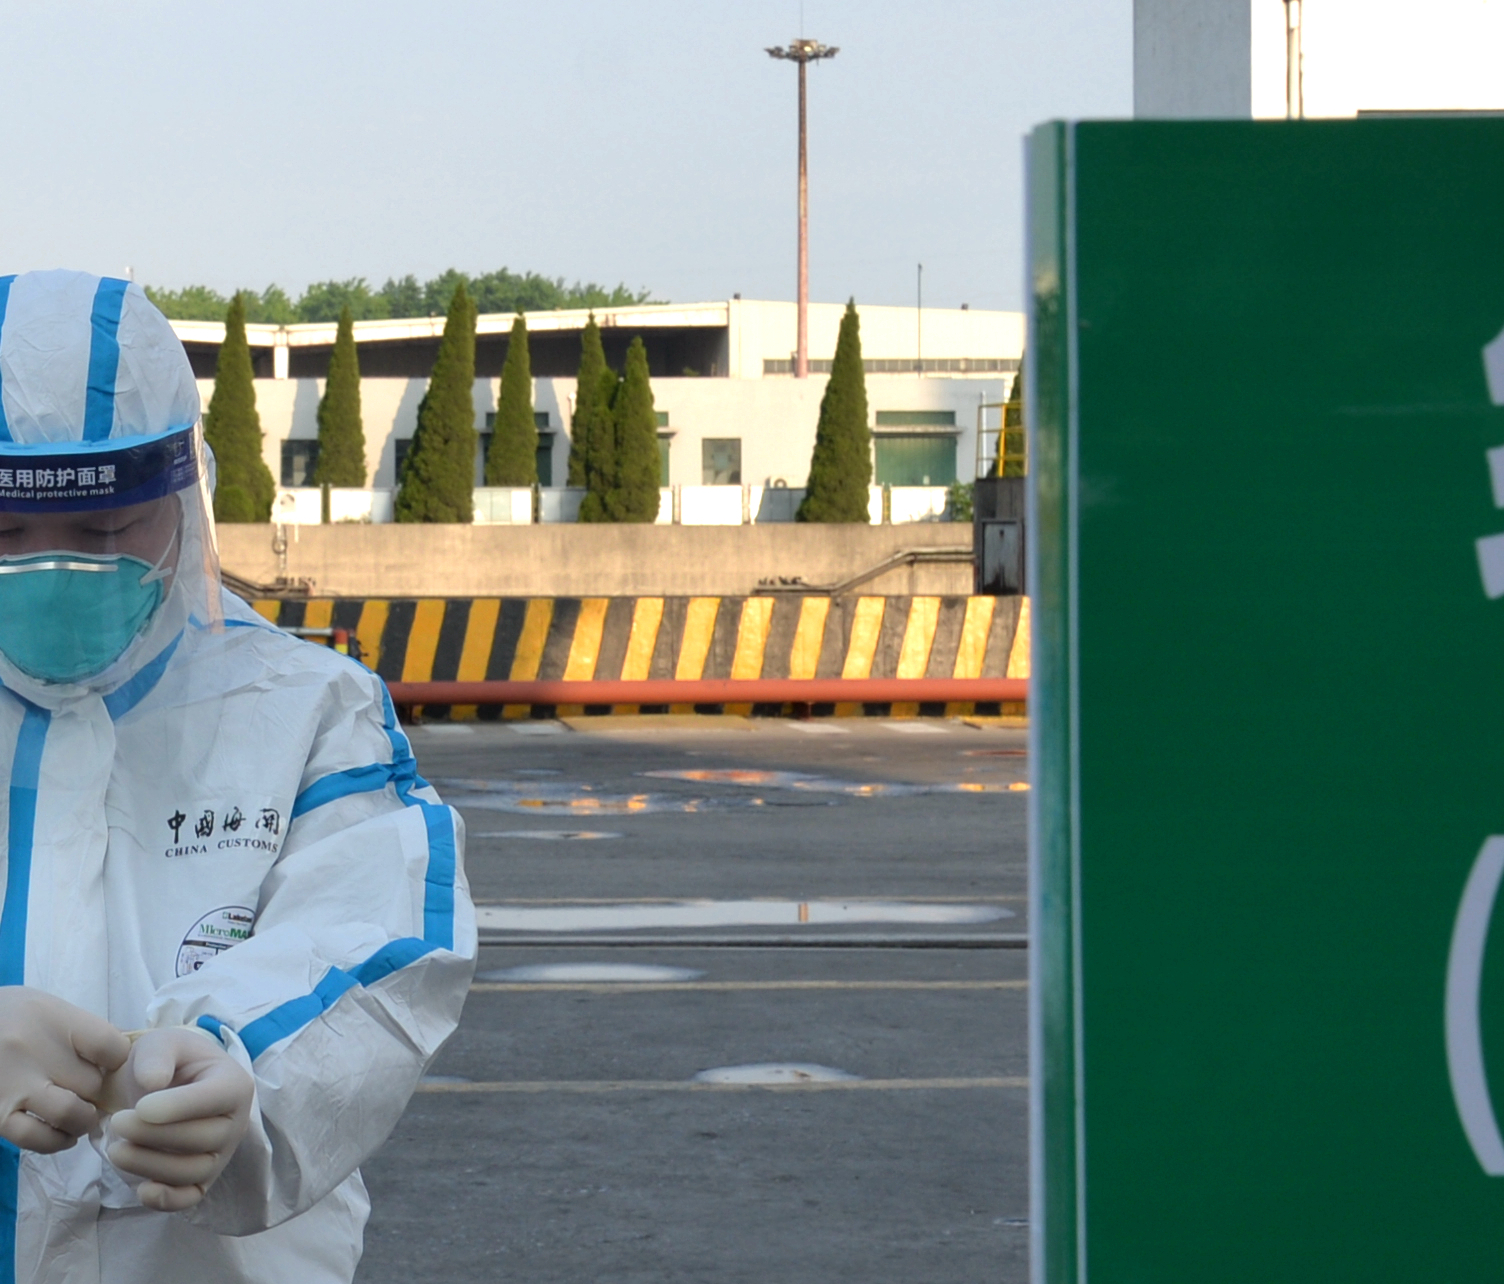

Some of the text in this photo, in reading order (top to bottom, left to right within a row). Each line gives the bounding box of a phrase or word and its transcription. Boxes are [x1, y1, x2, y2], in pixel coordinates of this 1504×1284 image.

[36, 489, 87, 500] protective
[90, 486, 115, 496] mask
[165, 837, 279, 858] CHINA CUSTOMS
